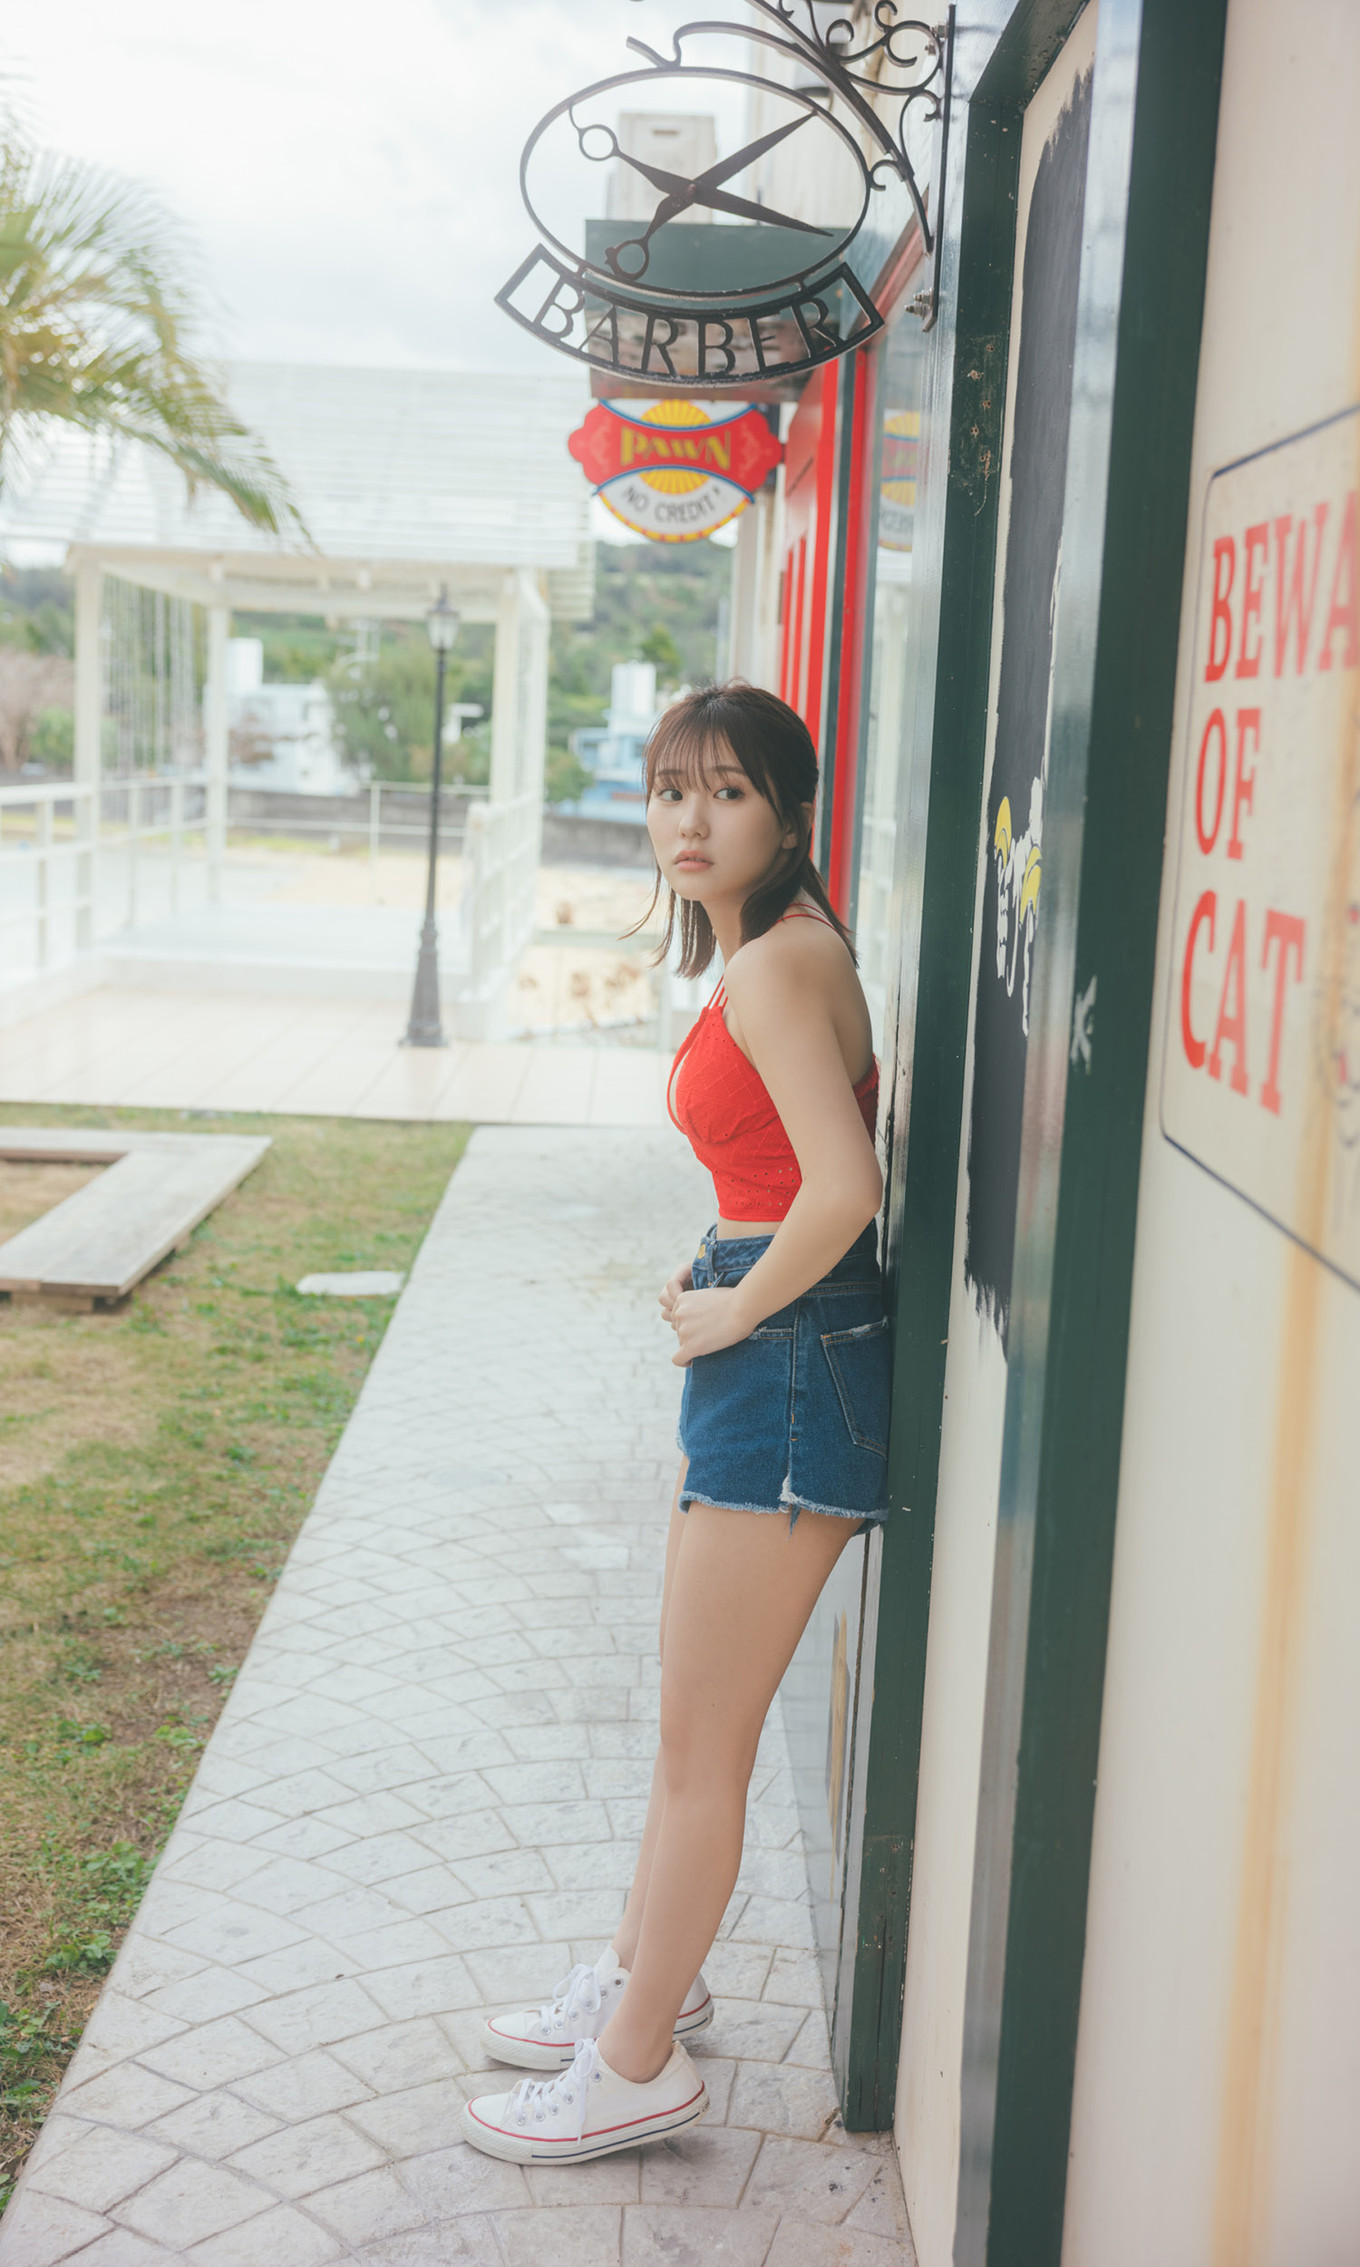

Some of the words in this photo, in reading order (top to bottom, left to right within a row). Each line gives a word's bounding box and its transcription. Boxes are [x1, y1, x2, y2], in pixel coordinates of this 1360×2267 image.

[531, 272, 847, 378] BARBER
[620, 425, 731, 471] PAWN
[622, 485, 650, 514] NO
[1194, 706, 1262, 861] OF
[1180, 888, 1307, 1119] CAT
